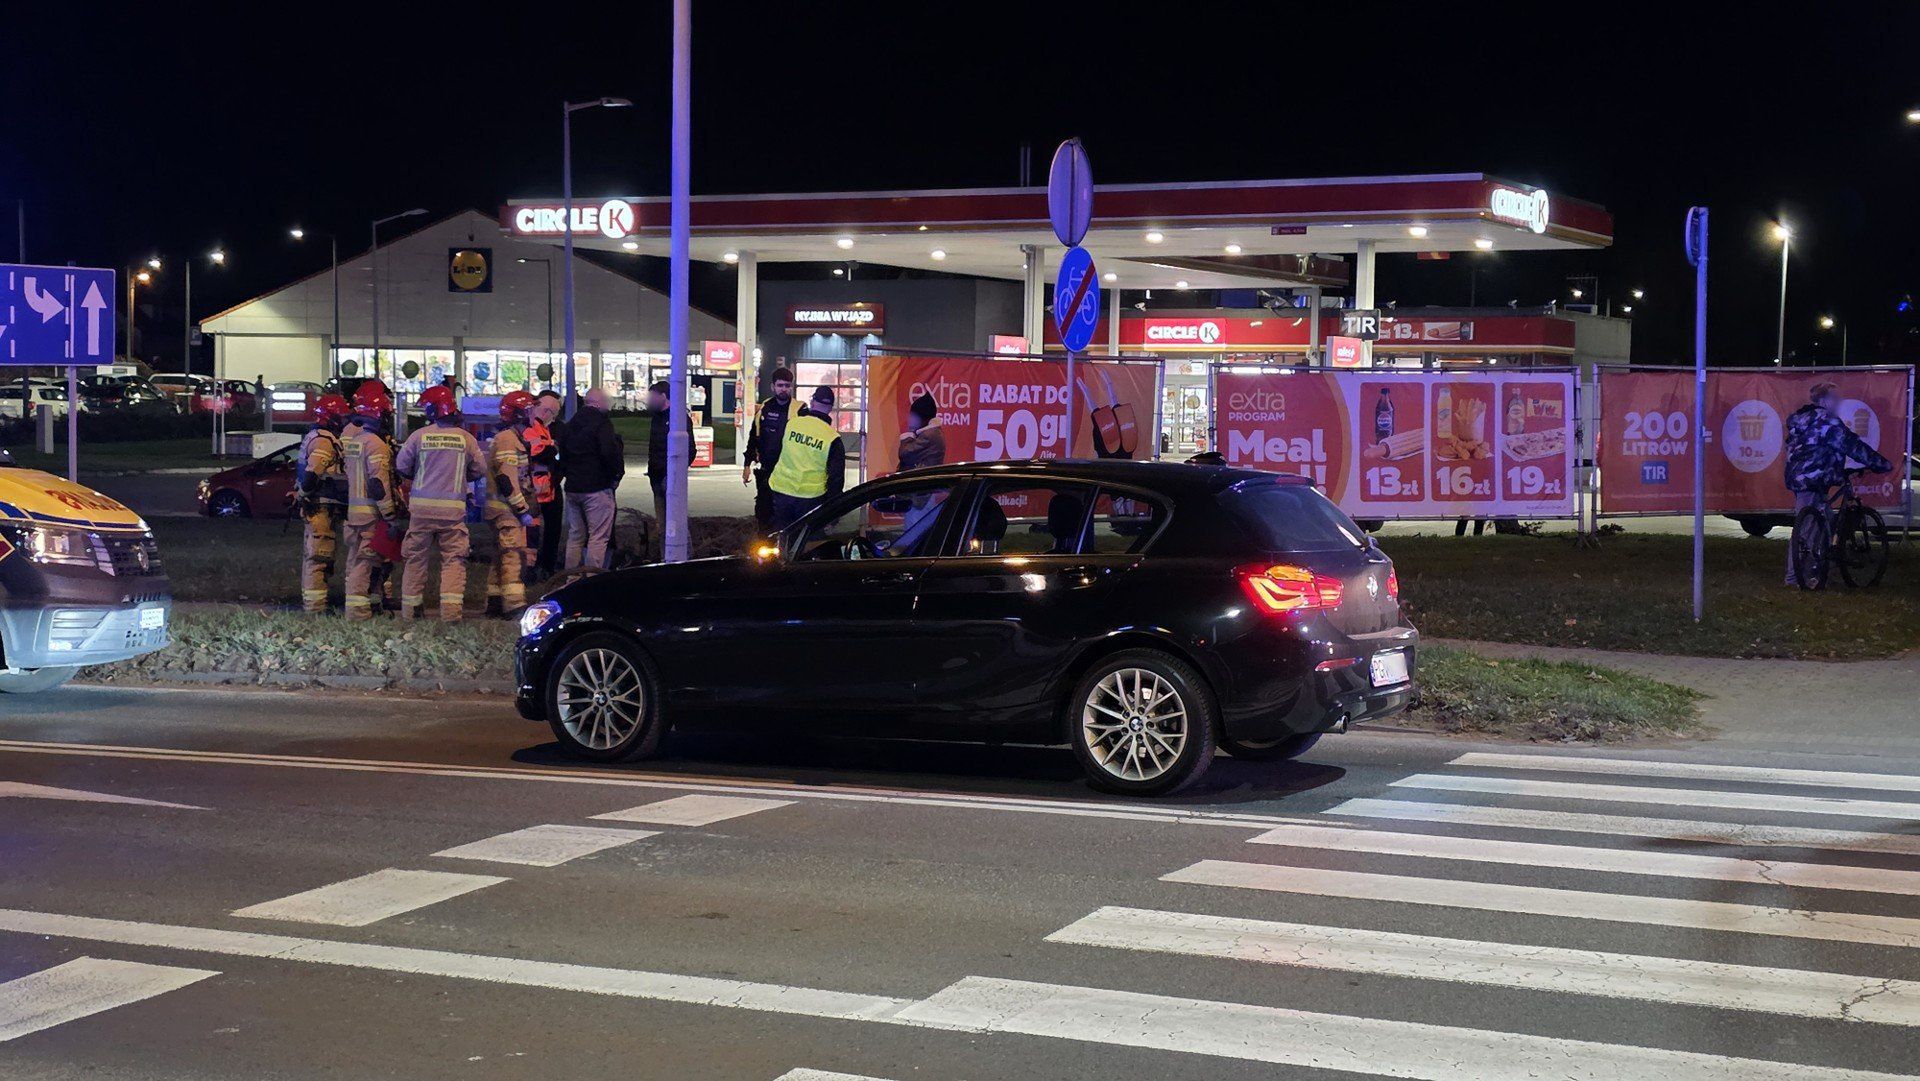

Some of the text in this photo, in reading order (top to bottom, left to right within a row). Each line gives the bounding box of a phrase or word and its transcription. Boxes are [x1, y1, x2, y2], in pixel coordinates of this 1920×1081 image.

[515, 207, 599, 233] CIRCLE
[1147, 325, 1199, 340] CIRCLE
[1343, 316, 1377, 335] TIR
[978, 384, 1043, 404] RABAT
[1229, 388, 1285, 411] extra
[1228, 412, 1285, 422] PROGRAM
[1623, 411, 1688, 440] 200
[789, 431, 824, 451] POLICJA
[974, 409, 1039, 461] 50
[1228, 428, 1327, 463] Meal
[1622, 439, 1688, 456] LITRÓW
[1643, 465, 1667, 480] TIR
